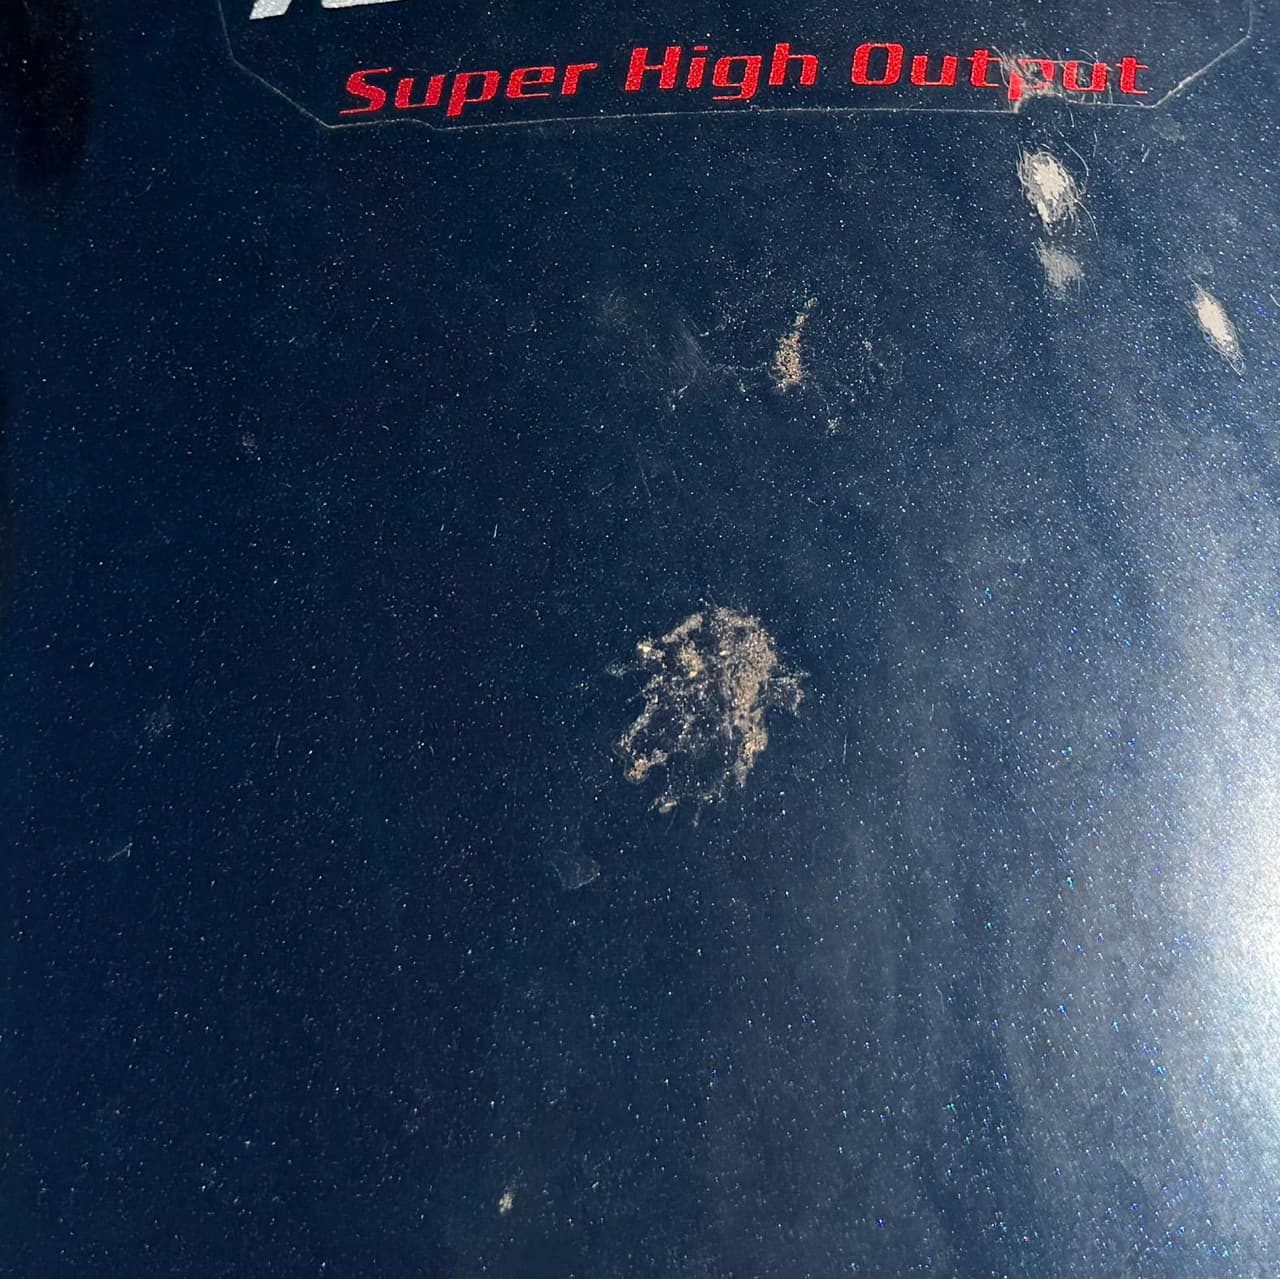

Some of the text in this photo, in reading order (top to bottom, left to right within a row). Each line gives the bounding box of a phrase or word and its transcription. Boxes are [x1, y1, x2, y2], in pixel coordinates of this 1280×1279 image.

[338, 42, 1149, 118] Super High Output
